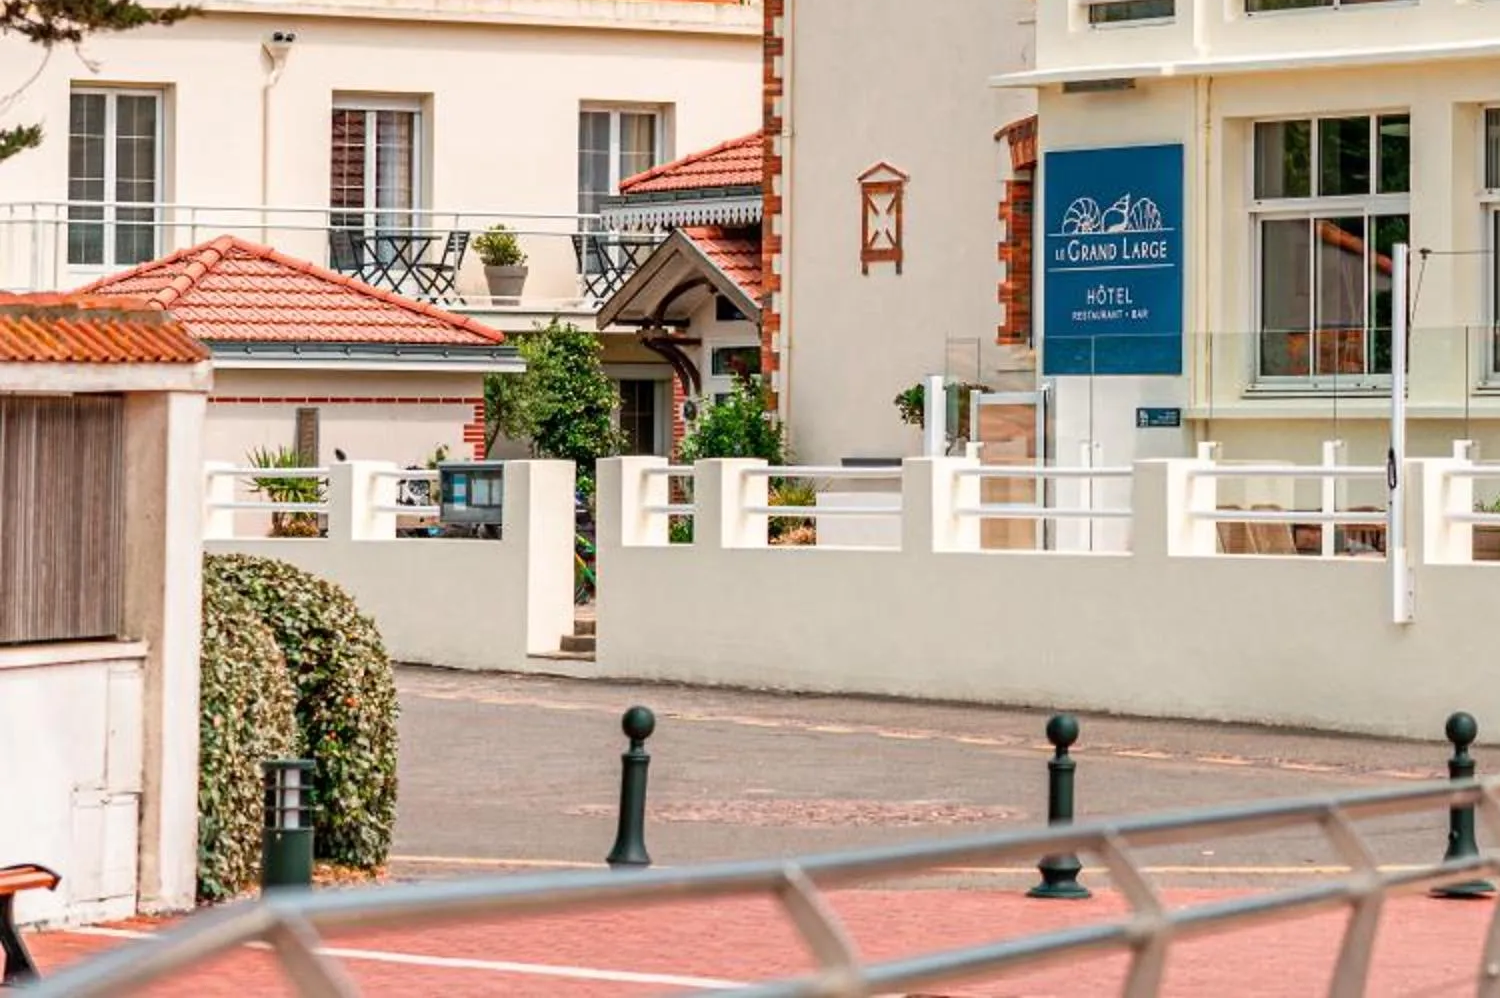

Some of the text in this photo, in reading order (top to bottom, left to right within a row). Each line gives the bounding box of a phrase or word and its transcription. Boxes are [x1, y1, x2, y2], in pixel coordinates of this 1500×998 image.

[1055, 237, 1167, 262] LE GRAND LARGE
[1087, 284, 1133, 305] HÔTEL
[1071, 309, 1123, 321] RESTAURANT
